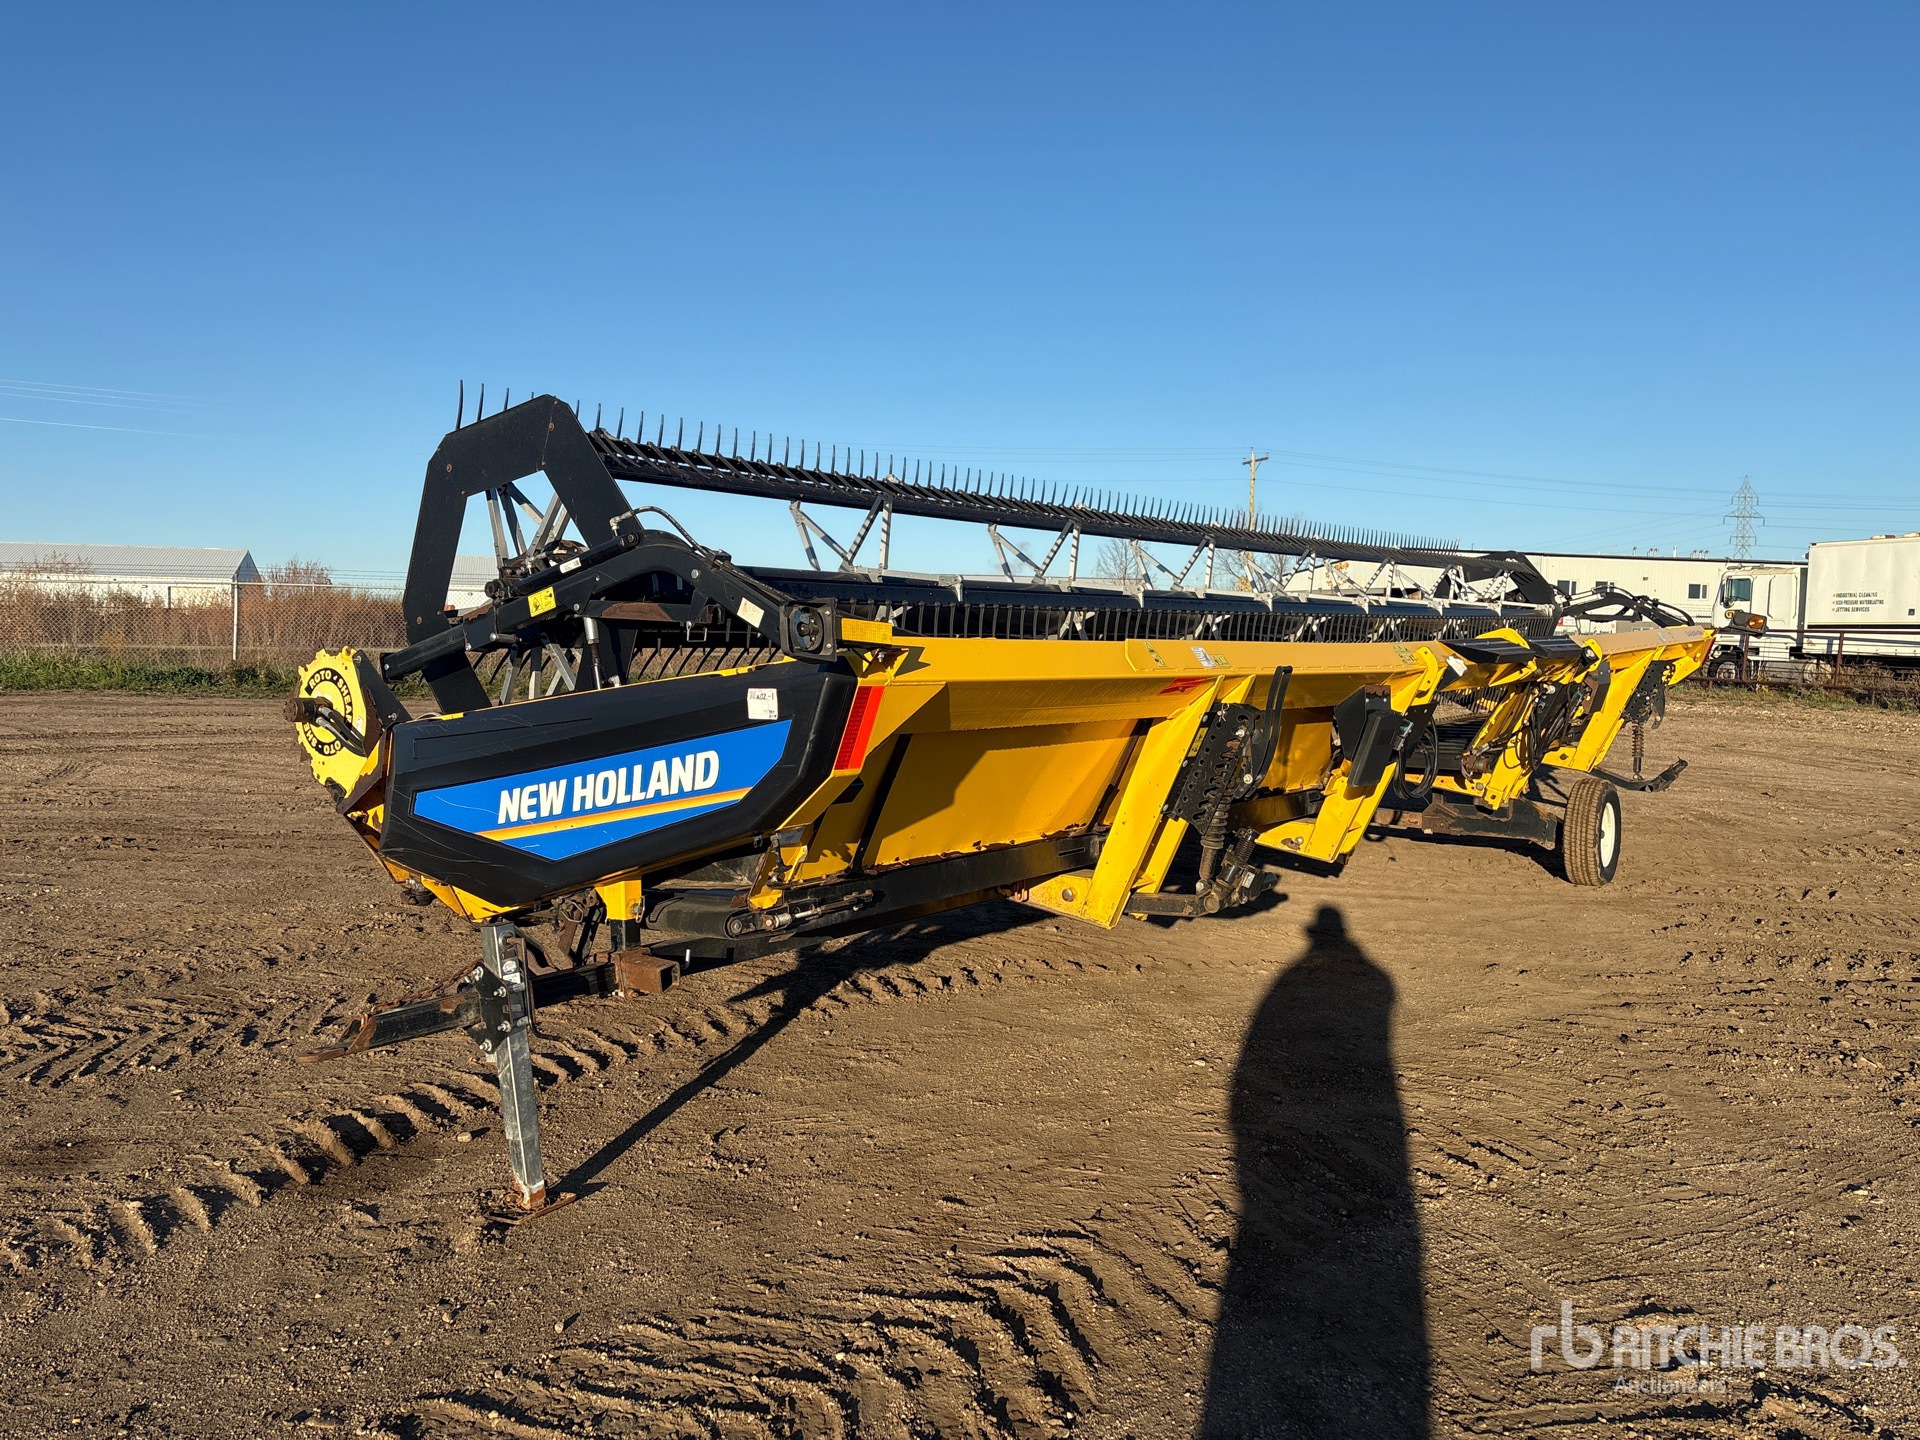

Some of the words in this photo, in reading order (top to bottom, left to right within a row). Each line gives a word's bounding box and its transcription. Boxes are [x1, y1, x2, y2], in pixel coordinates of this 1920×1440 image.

[308, 670, 332, 689] ROTO
[303, 721, 318, 748] SHE
[323, 739, 342, 755] OTO
[497, 779, 567, 825] NEW
[572, 750, 720, 810] HOLLAND
